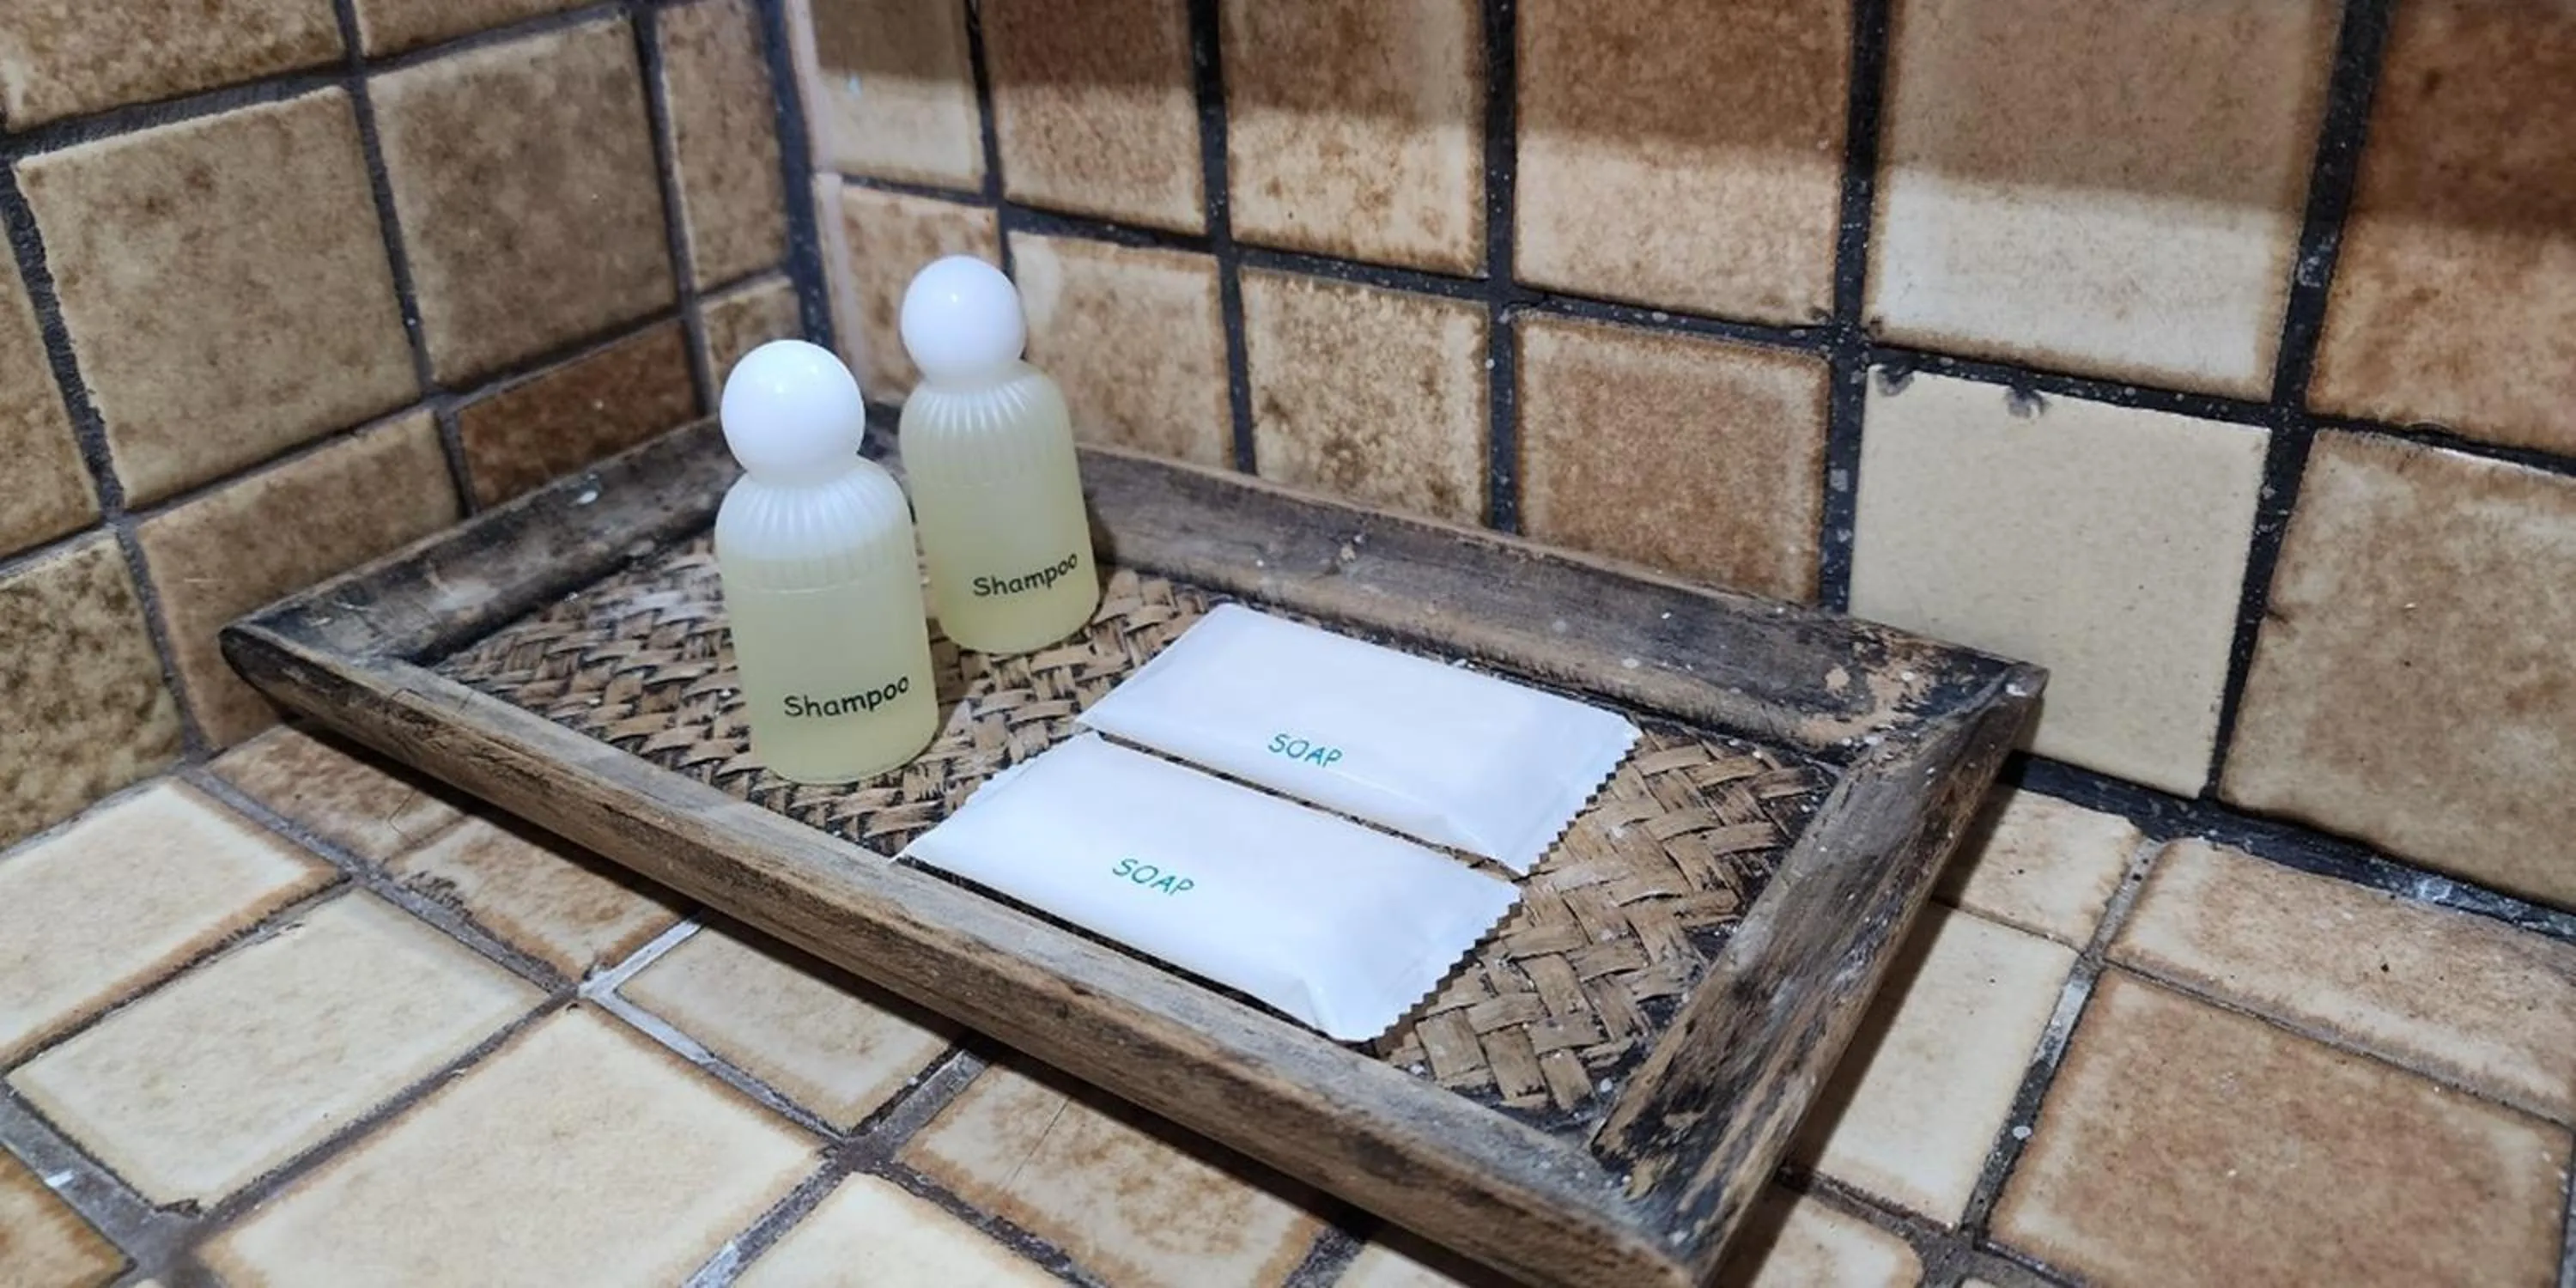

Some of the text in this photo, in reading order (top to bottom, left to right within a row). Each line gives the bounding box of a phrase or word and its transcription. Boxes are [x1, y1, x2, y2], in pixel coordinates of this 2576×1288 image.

[972, 552, 1078, 598] Shampoo
[782, 675, 910, 718] Shampoo
[1267, 732, 1344, 769] SOAP
[1111, 857, 1196, 896] SOAP
